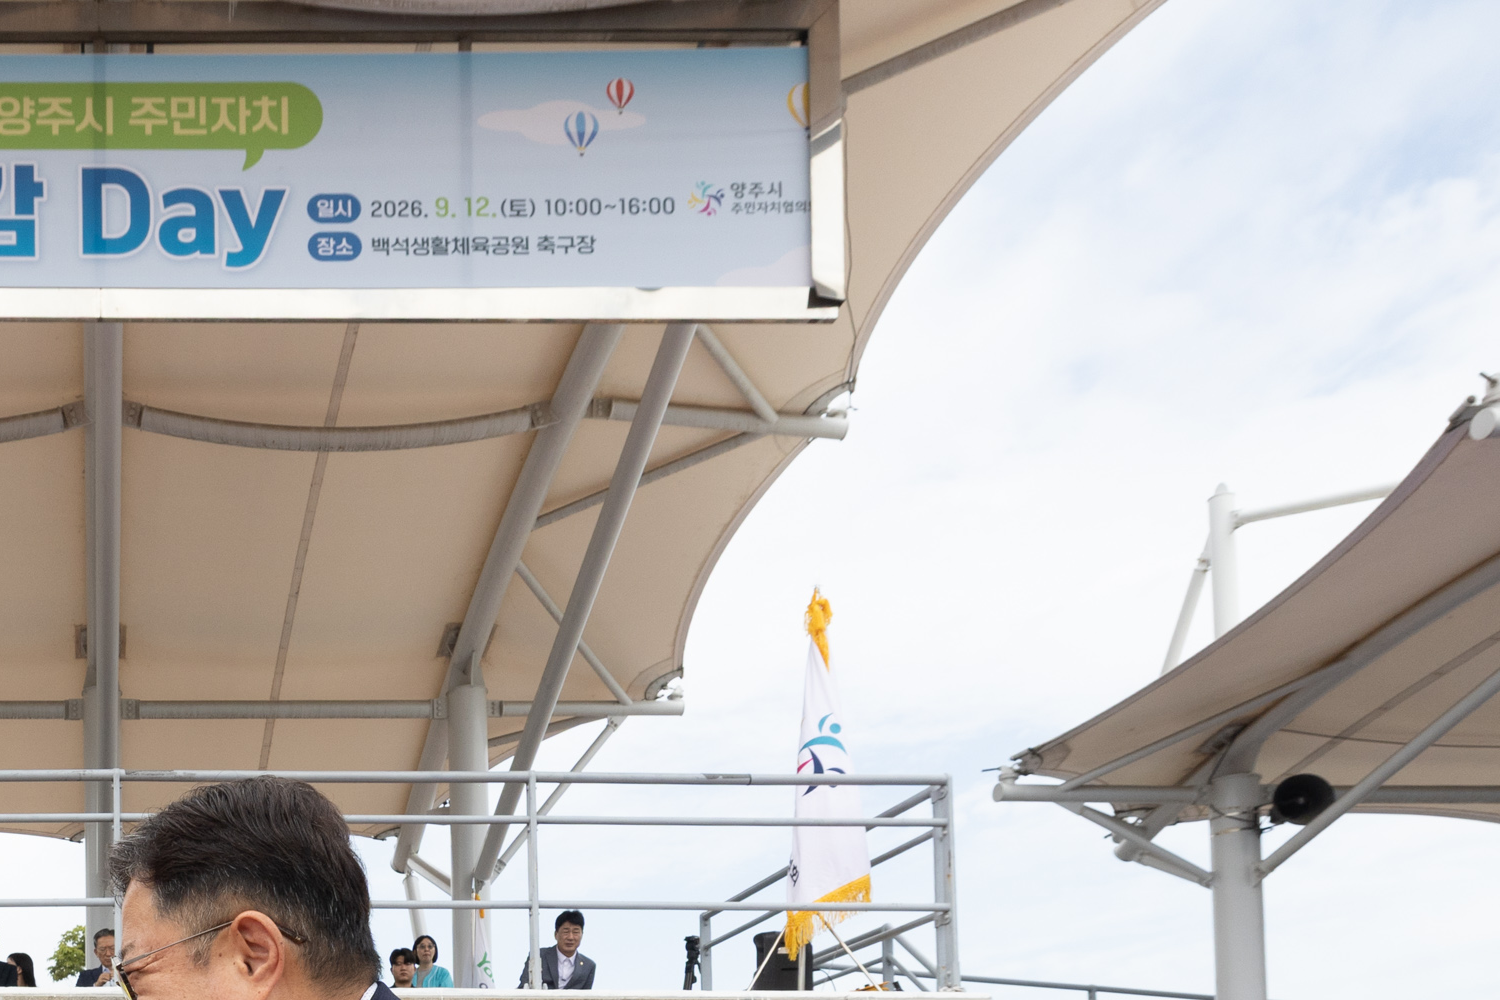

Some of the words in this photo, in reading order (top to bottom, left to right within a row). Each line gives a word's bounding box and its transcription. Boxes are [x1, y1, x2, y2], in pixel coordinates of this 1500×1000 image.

[128, 96, 288, 136] 주민자치
[730, 181, 783, 199] 양주시
[81, 166, 287, 268] Day
[316, 198, 352, 218] 일시
[370, 200, 428, 218] 2026.
[435, 197, 456, 218] 9.
[545, 198, 675, 216] 10:00~16:00
[731, 200, 810, 215] 주민자치협의
[316, 237, 354, 255] 장소
[371, 236, 530, 256] 백석생활체육공원
[536, 235, 597, 255] 축구장
